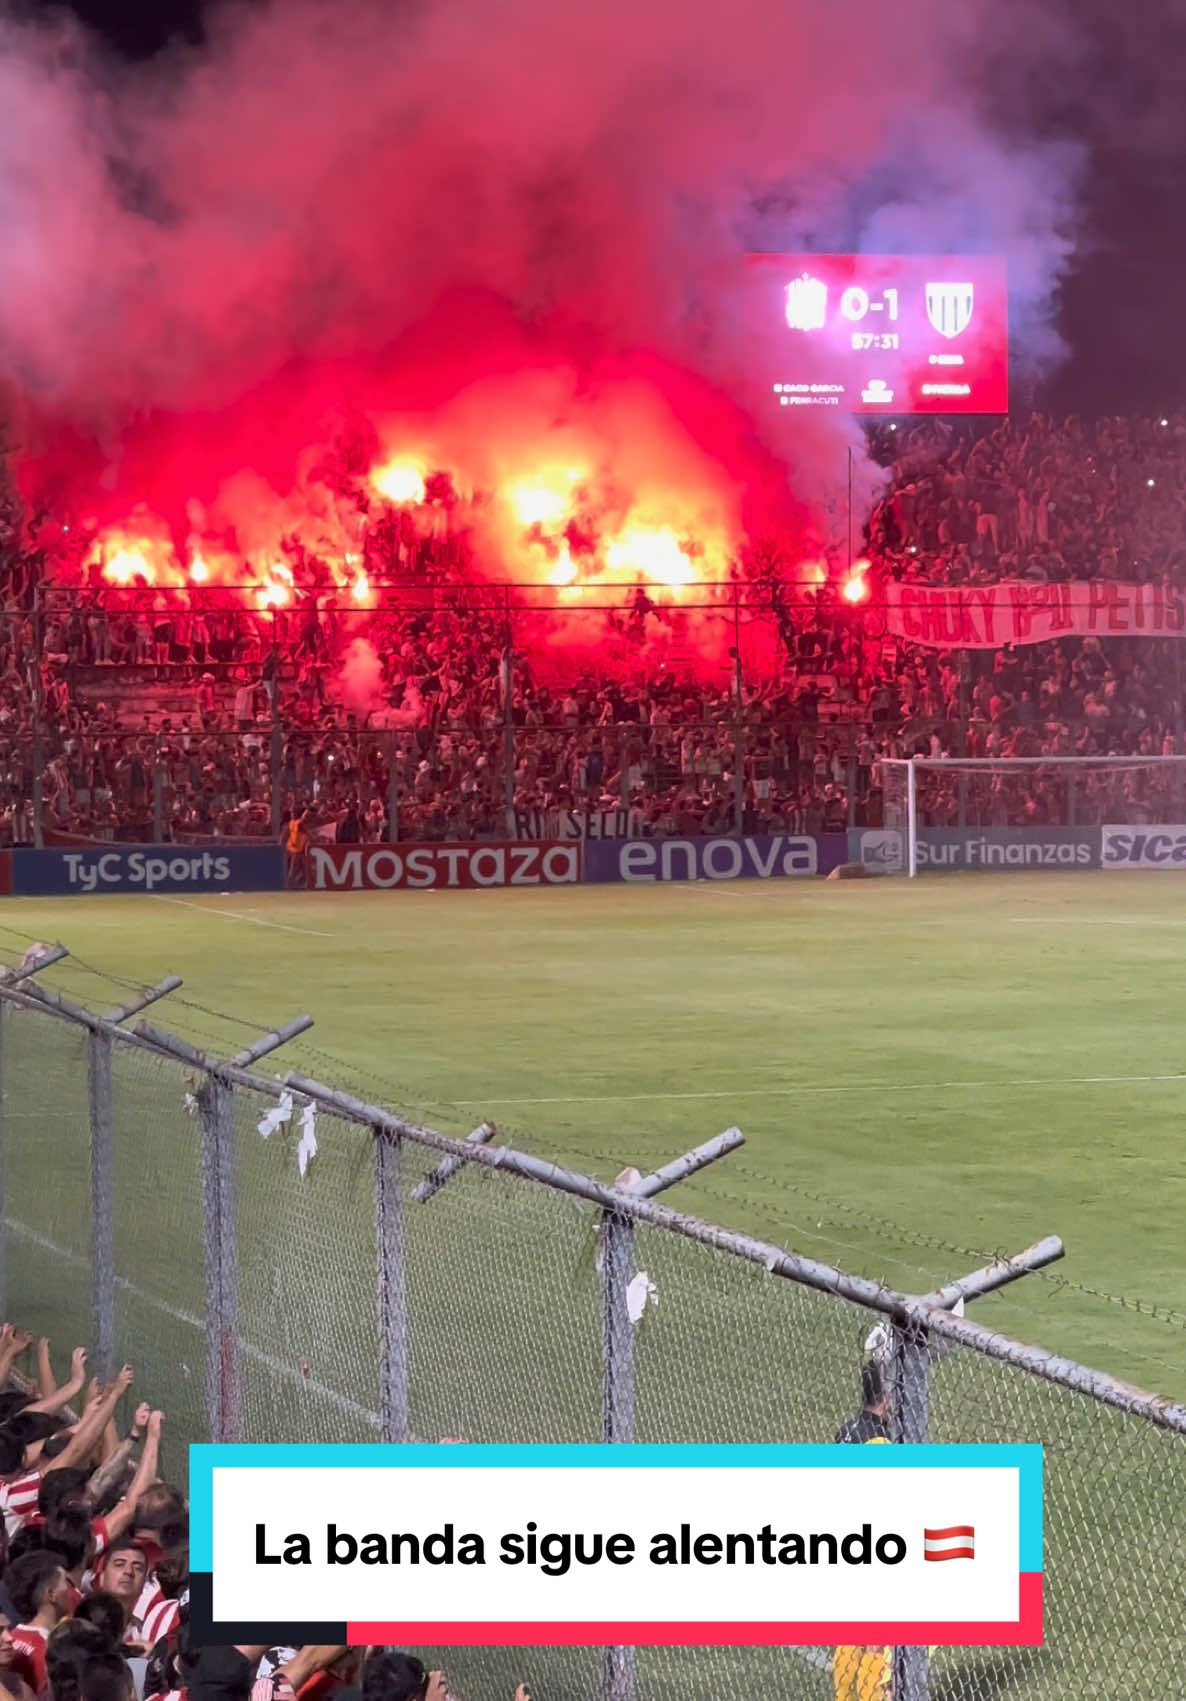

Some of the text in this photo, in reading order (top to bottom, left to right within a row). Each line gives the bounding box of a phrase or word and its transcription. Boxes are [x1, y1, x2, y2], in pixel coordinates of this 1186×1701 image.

[840, 287, 899, 321] 0-1
[618, 835, 819, 881] enova
[914, 836, 1091, 864] Sur Finanzas
[63, 852, 231, 891] TyC Sports
